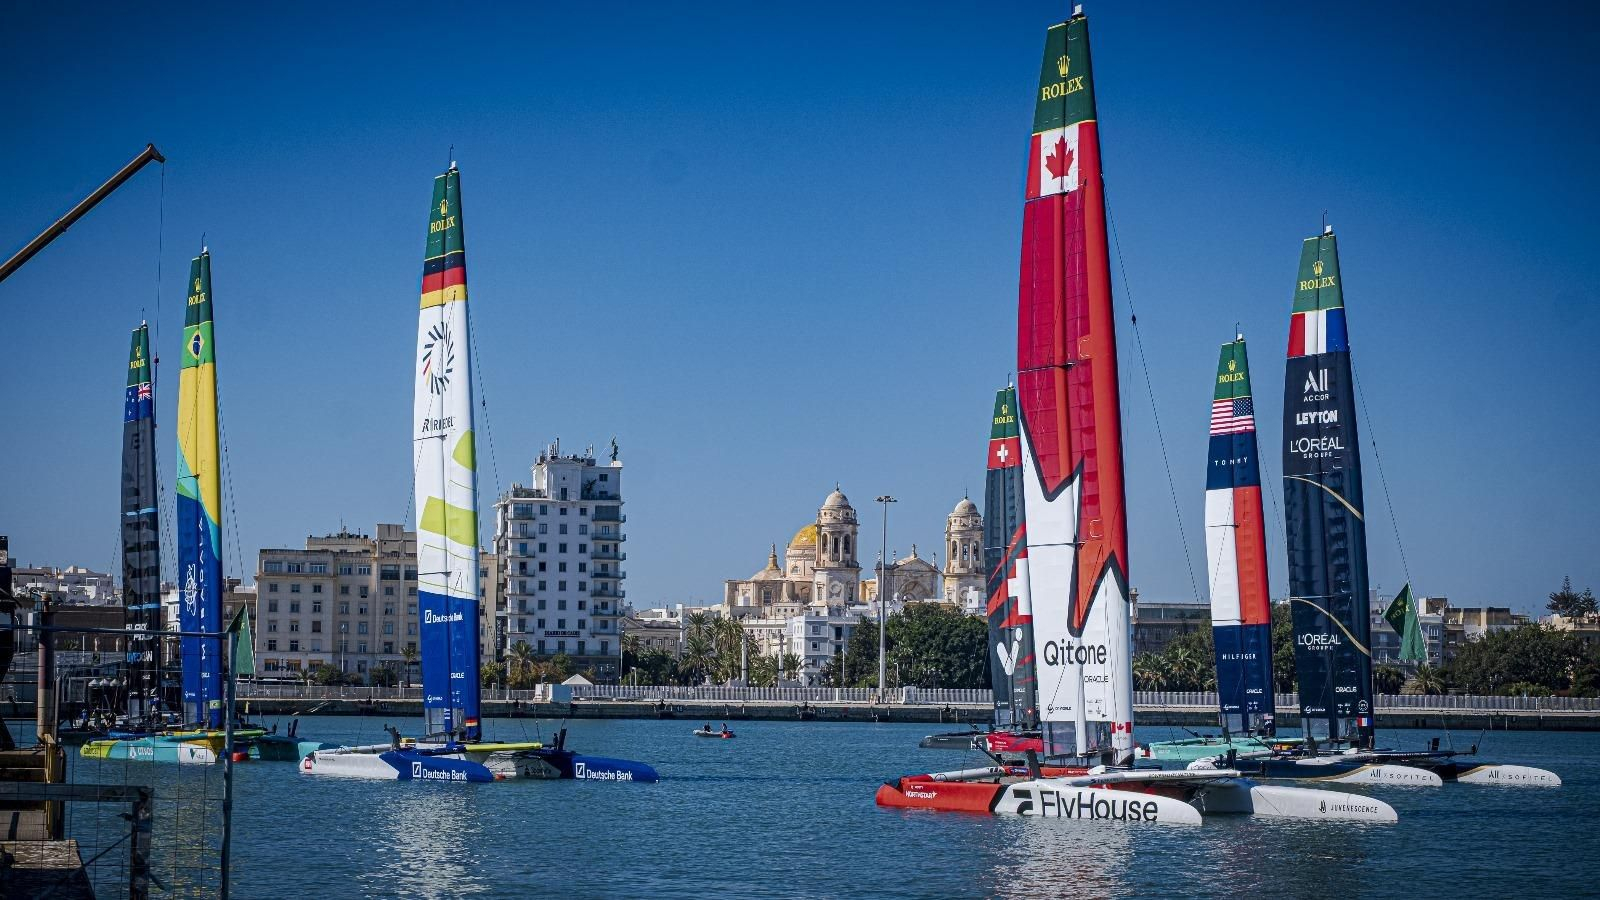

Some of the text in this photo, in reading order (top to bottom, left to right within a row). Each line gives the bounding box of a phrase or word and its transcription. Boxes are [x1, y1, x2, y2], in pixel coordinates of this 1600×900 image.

[1041, 76, 1084, 101] ROLEX
[430, 216, 456, 234] ROLEX
[1300, 275, 1336, 291] ROLEX
[1218, 372, 1245, 384] ROLEX
[1303, 393, 1330, 402] ACCOR
[994, 415, 1014, 425] ROLEX
[1296, 410, 1338, 425] LEYTON
[1290, 436, 1345, 453] L'ORÉAL
[1214, 456, 1248, 466] TOMMY
[1297, 632, 1341, 645] L'ORÉAL
[1043, 638, 1107, 667] Qitone
[1084, 675, 1109, 683] ORACLE
[422, 768, 467, 780] Deutsche Bank
[586, 769, 633, 781] Deutsche Bank
[1389, 773, 1434, 781] SOFITEL
[1330, 804, 1379, 814] JUVENESCENCE
